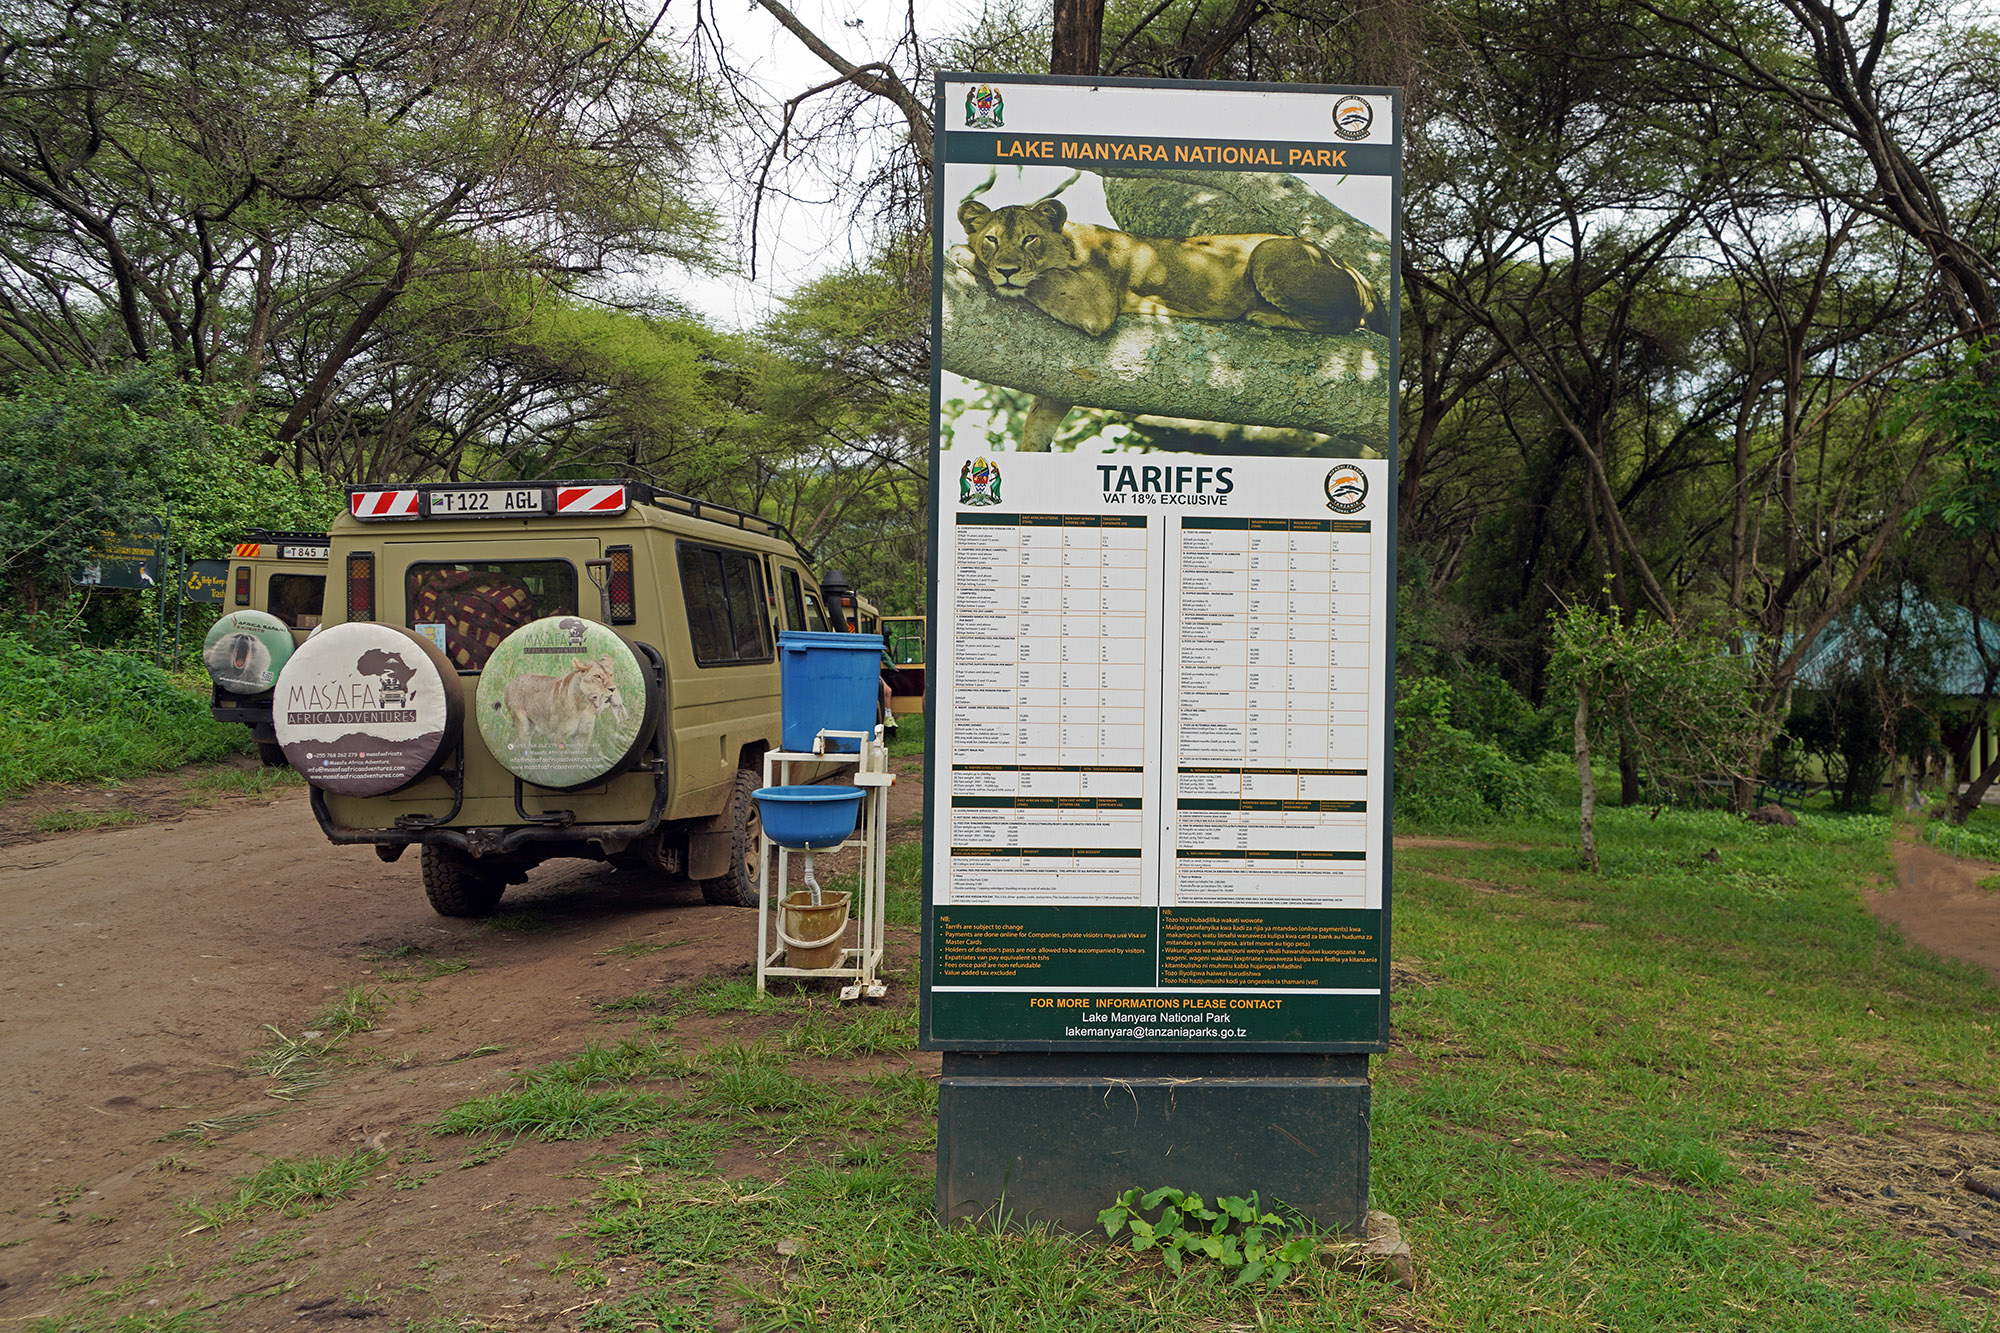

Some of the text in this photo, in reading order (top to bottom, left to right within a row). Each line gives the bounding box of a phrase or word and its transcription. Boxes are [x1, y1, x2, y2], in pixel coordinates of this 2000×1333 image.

[996, 140, 1347, 167] LAKE MANYARA NATIONAL PARK
[1097, 465, 1234, 494] TARIFFS
[444, 492, 537, 510] T 122 AGL
[1103, 494, 1227, 505] VAT 18% EXCLUSIVE
[298, 548, 316, 556] 845
[202, 576, 224, 587] Help Keep
[524, 634, 568, 646] MASAFA
[288, 684, 376, 710] MASAFA
[288, 711, 415, 724] AFRICA ADVENTURES
[1030, 998, 1282, 1009] FOR MORE INFORMATIONS PLEASE CONTACT
[1083, 1013, 1230, 1025] Lake Manyara National Park
[1066, 1027, 1246, 1039] lakemanyara@tanzaniaparks.go.tz
